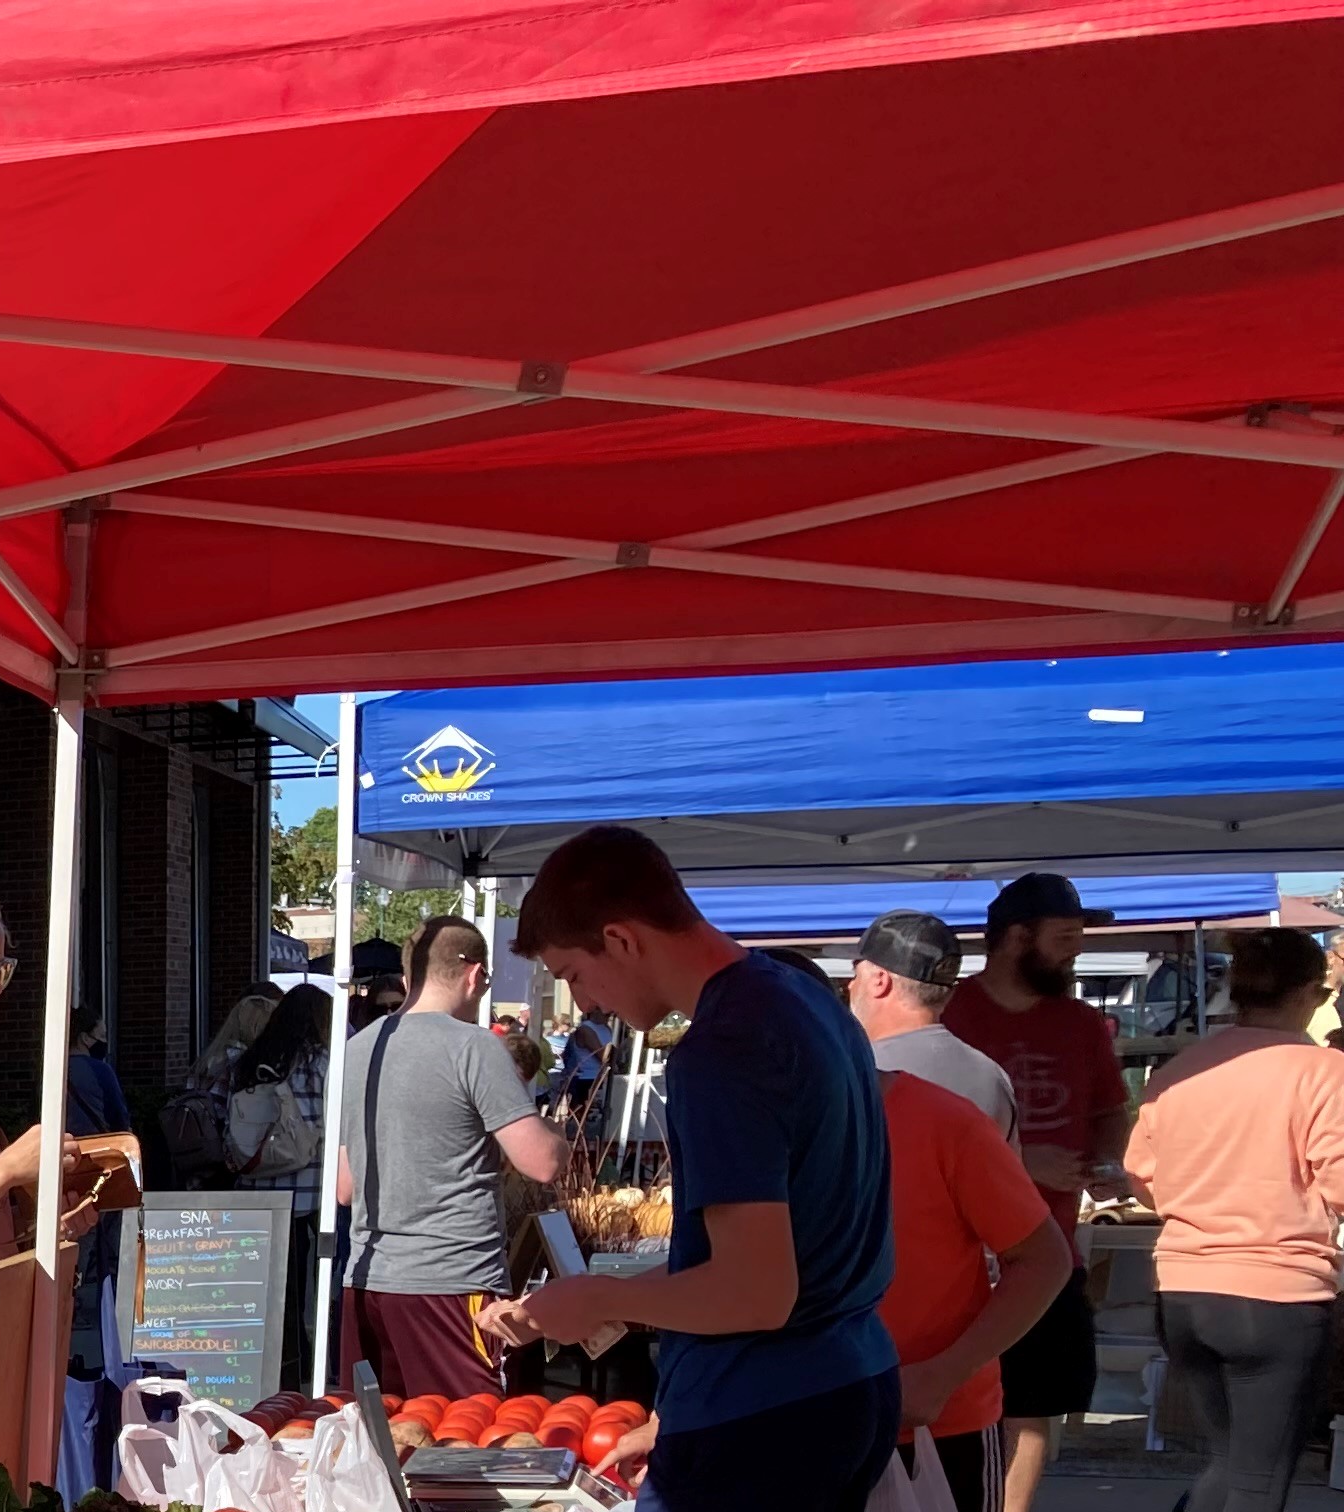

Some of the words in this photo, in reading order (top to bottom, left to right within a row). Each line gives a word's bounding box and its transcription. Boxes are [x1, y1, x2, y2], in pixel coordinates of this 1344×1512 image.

[401, 792, 444, 803] CROWN
[446, 791, 491, 802] SHADES
[195, 1239, 233, 1251] GRAVY
[145, 1279, 184, 1290] AVORY
[205, 1376, 235, 1384] DOUGH
